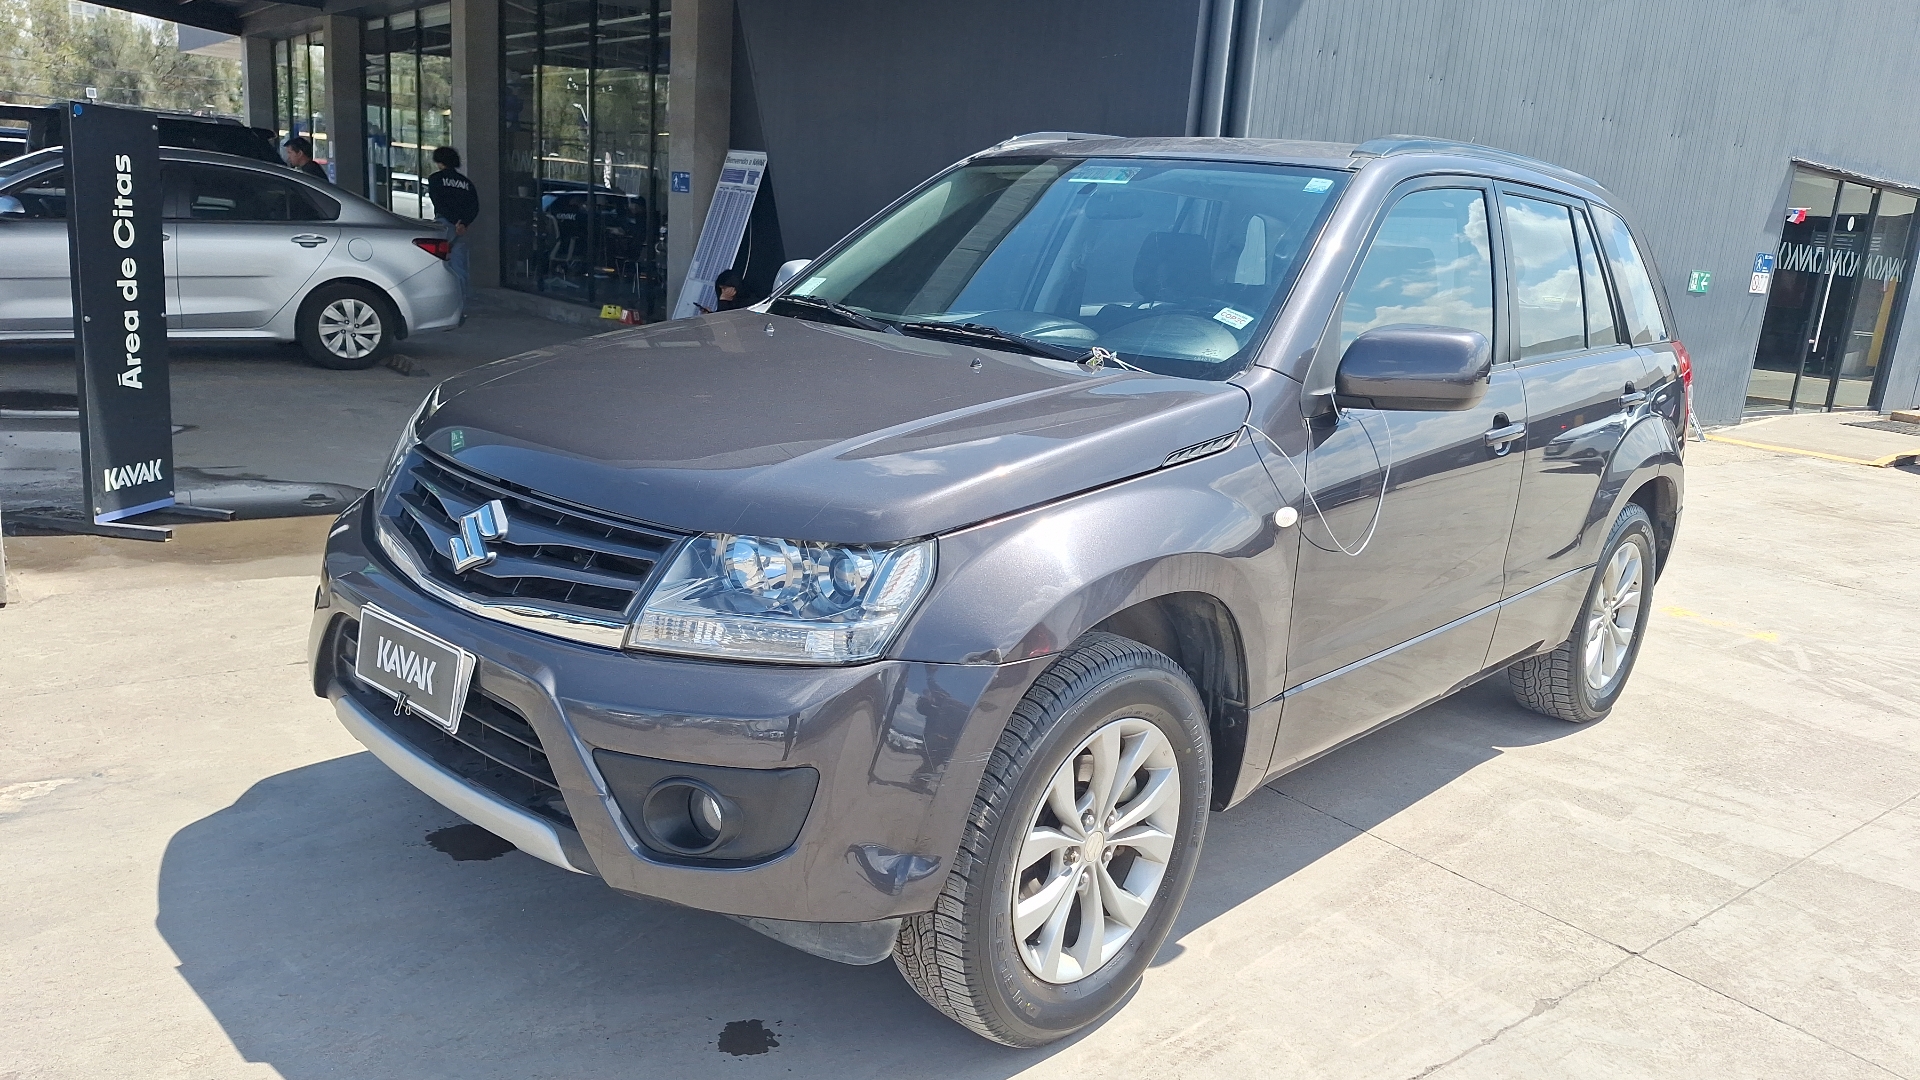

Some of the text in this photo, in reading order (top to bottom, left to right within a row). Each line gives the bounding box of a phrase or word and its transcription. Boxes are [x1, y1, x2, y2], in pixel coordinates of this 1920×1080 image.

[442, 177, 469, 191] KAVAK
[112, 154, 143, 389] Área de Citas
[103, 458, 163, 493] KAVAK
[377, 635, 437, 696] KAVAK
